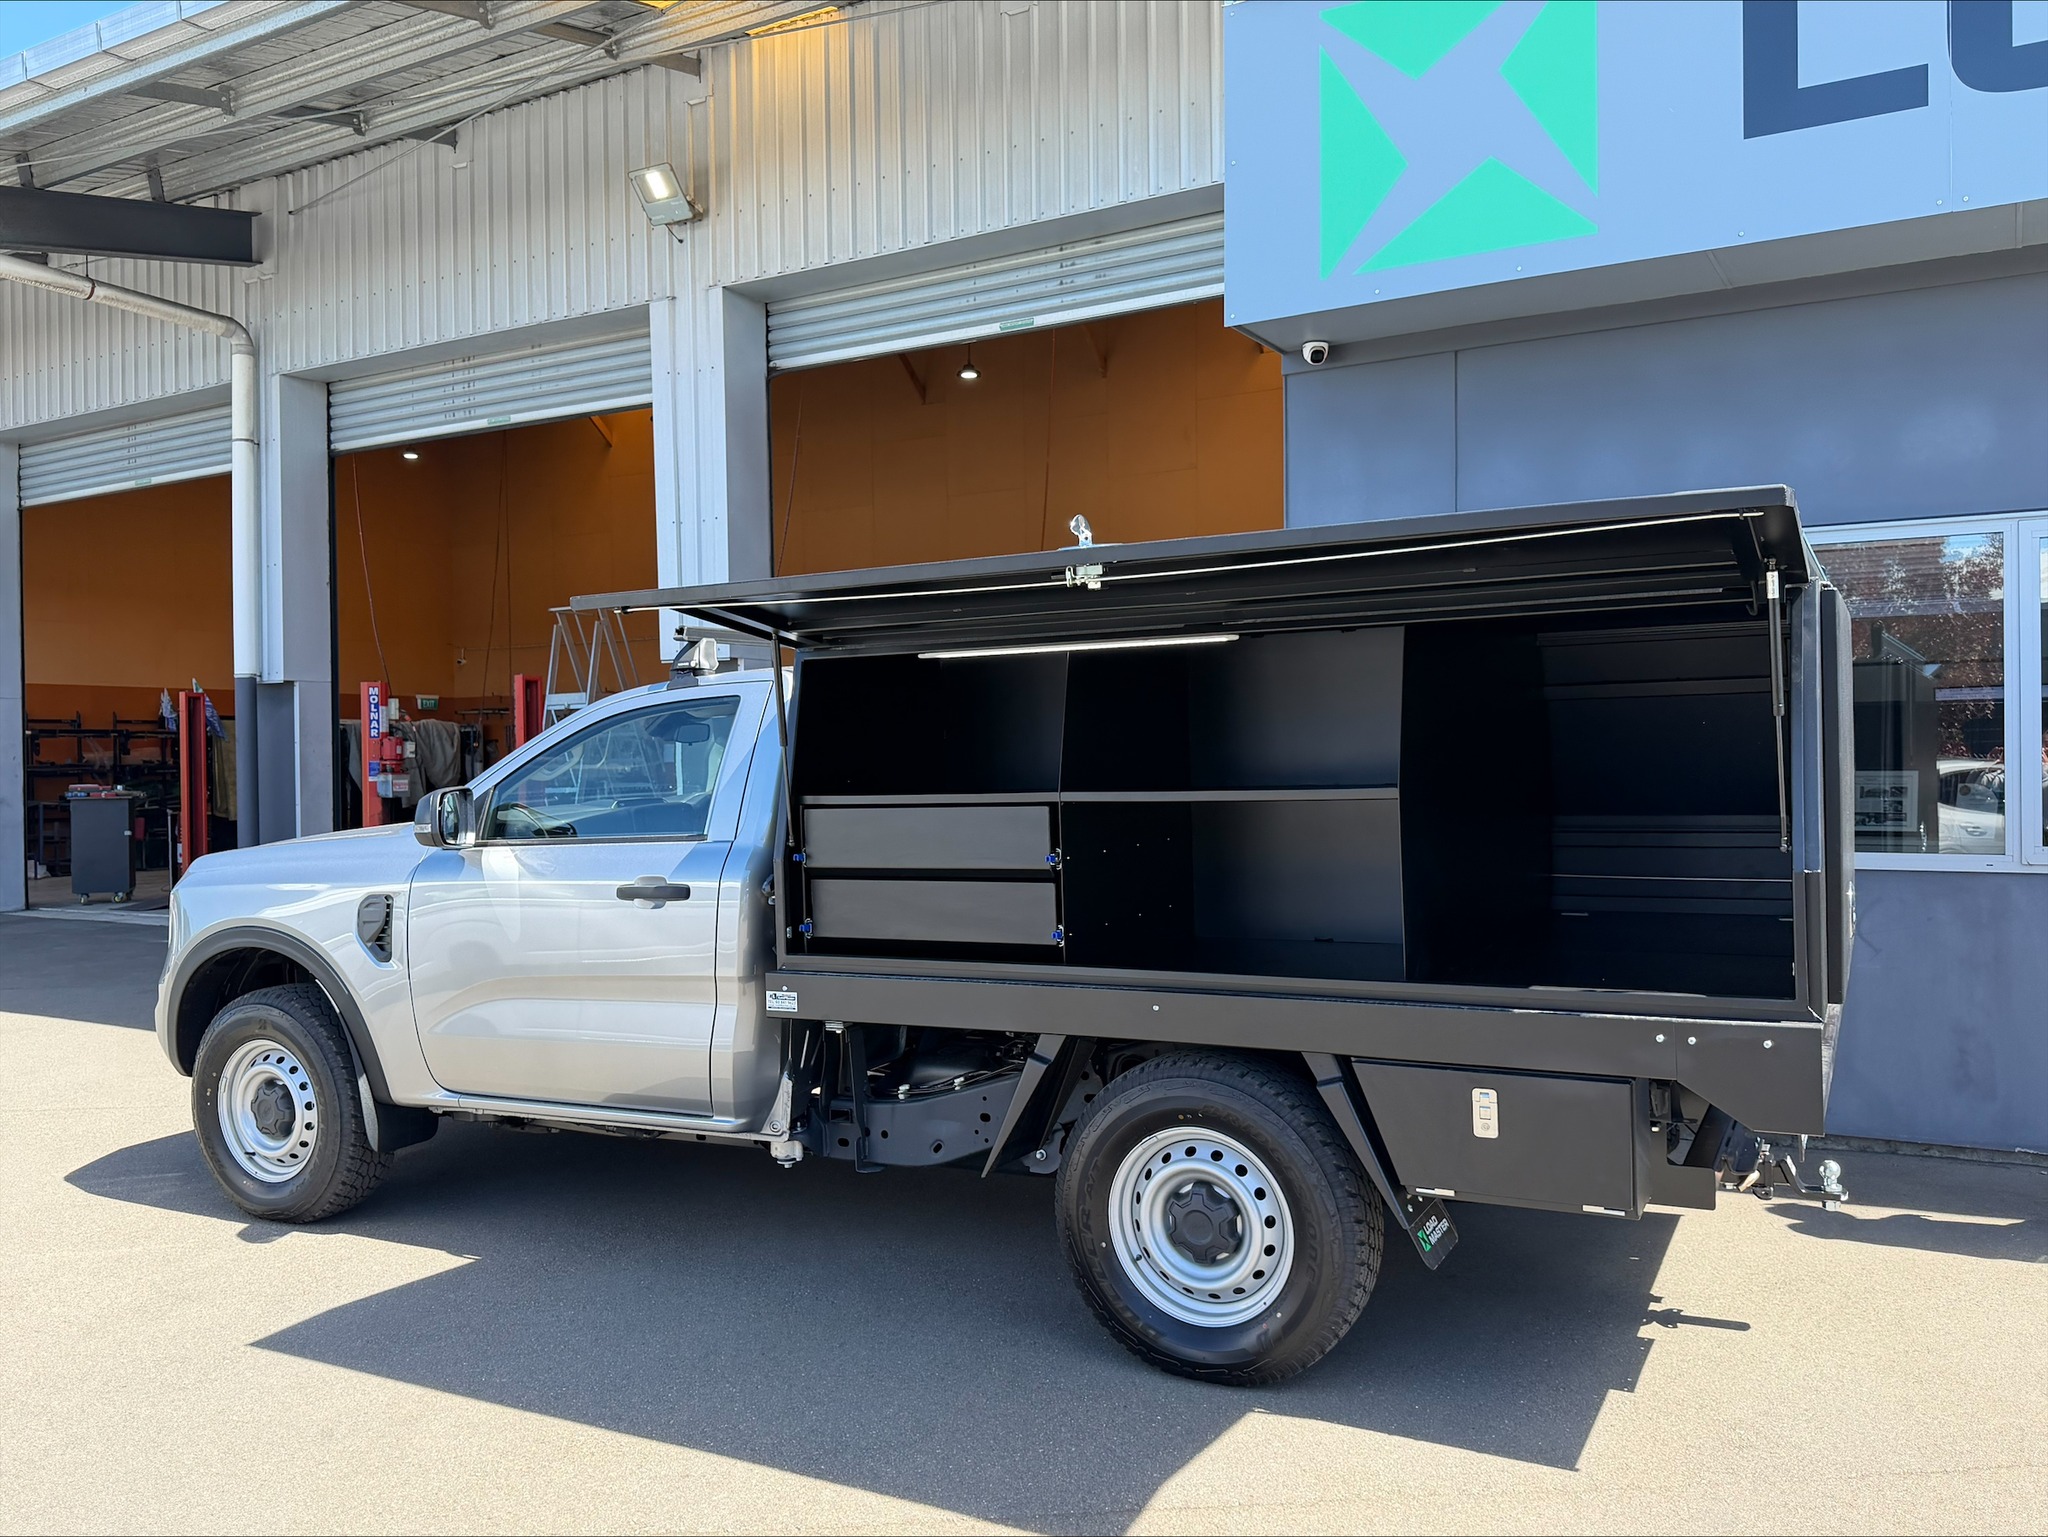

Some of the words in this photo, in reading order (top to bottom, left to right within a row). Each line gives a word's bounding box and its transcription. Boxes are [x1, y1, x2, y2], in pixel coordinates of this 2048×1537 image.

[368, 686, 379, 737] MOLNAR
[422, 699, 436, 708] EXIT
[1423, 1215, 1438, 1235] LOAD
[1428, 1217, 1450, 1245] MASTER
